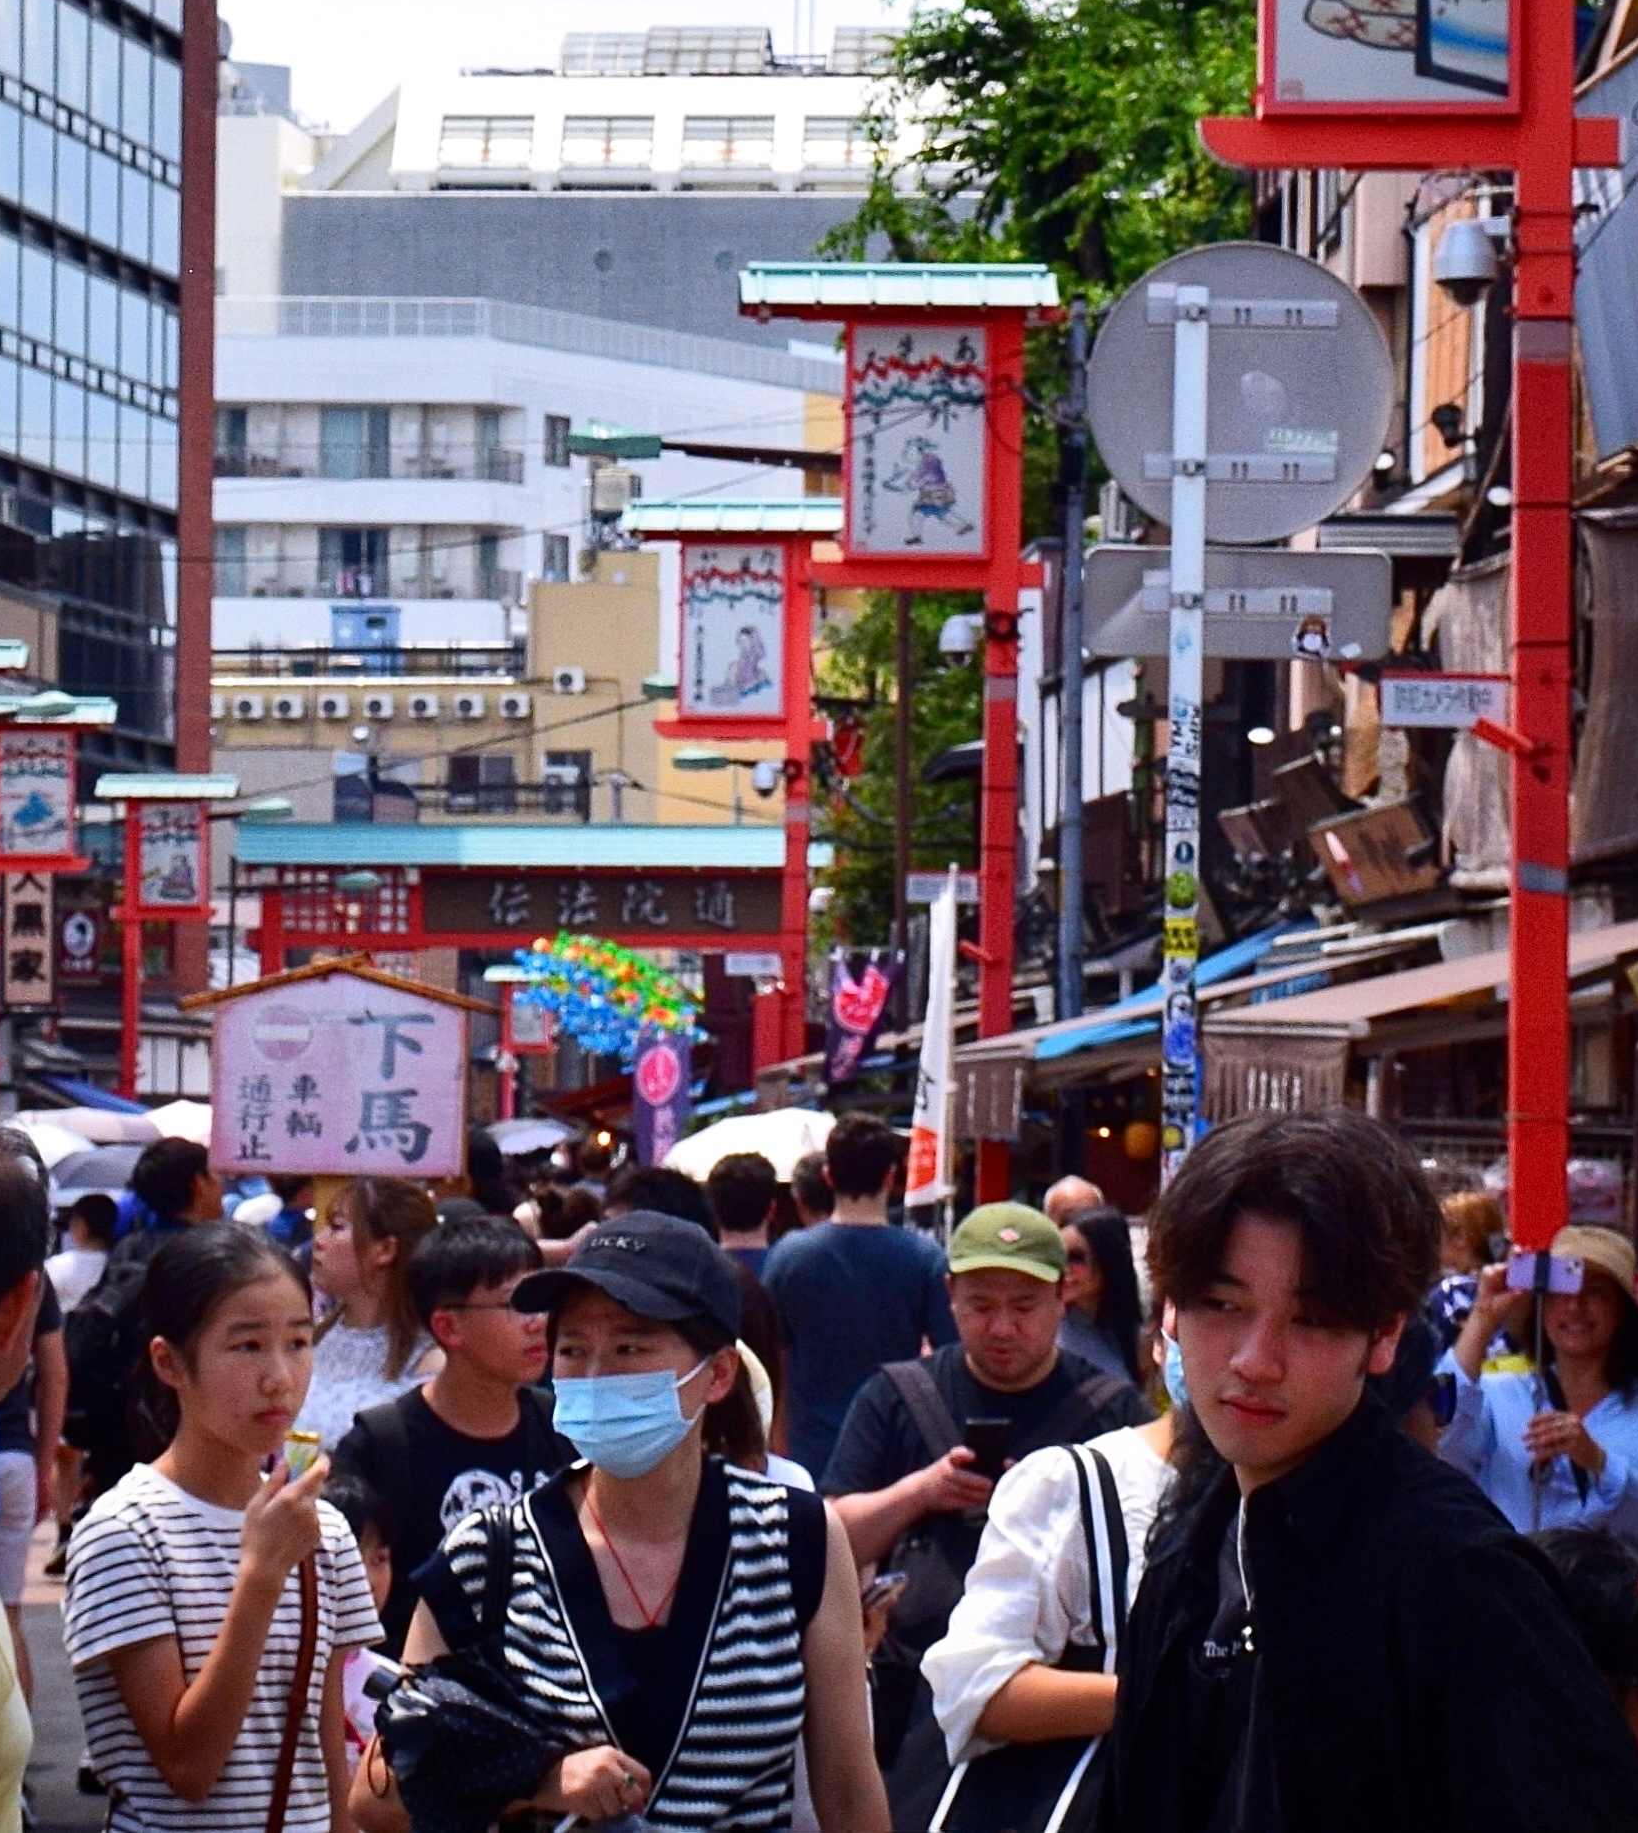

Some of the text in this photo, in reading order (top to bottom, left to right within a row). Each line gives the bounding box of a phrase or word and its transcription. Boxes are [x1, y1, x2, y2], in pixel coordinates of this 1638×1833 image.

[488, 879, 736, 928] 伝法院通
[237, 1074, 272, 1161] 通行止
[345, 1009, 435, 1164] 下馬
[590, 1235, 647, 1254] UCKY
